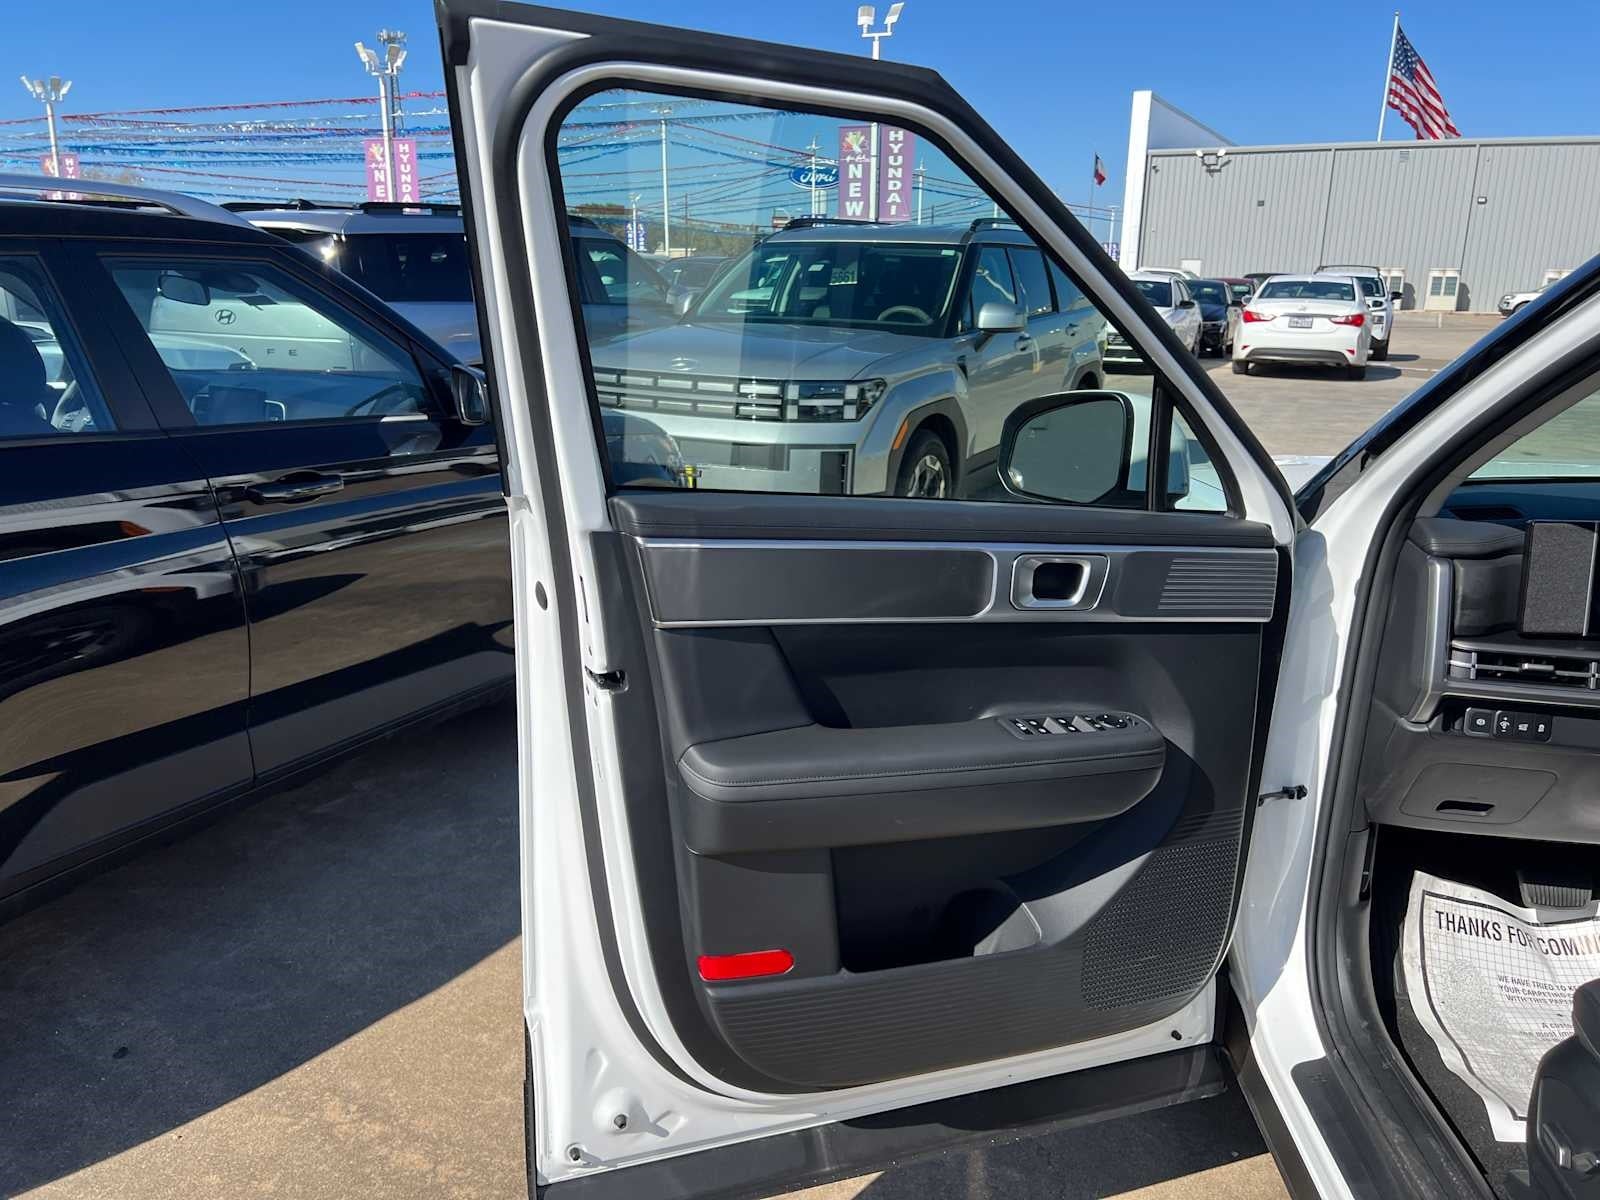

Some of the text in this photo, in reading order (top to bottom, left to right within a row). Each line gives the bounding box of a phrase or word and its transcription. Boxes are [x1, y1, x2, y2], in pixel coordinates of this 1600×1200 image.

[373, 169, 386, 203] NE
[398, 143, 413, 203] HYUNDA
[845, 163, 864, 217] NEW
[886, 130, 904, 216] HYUNDAI
[1435, 910, 1600, 956] THANKS FOR COMIN
[1497, 975, 1510, 983] WE
[1511, 976, 1530, 987] HAVE
[1531, 980, 1555, 991] TRIED
[1556, 984, 1567, 992] TO
[1498, 984, 1521, 995] YOUR
